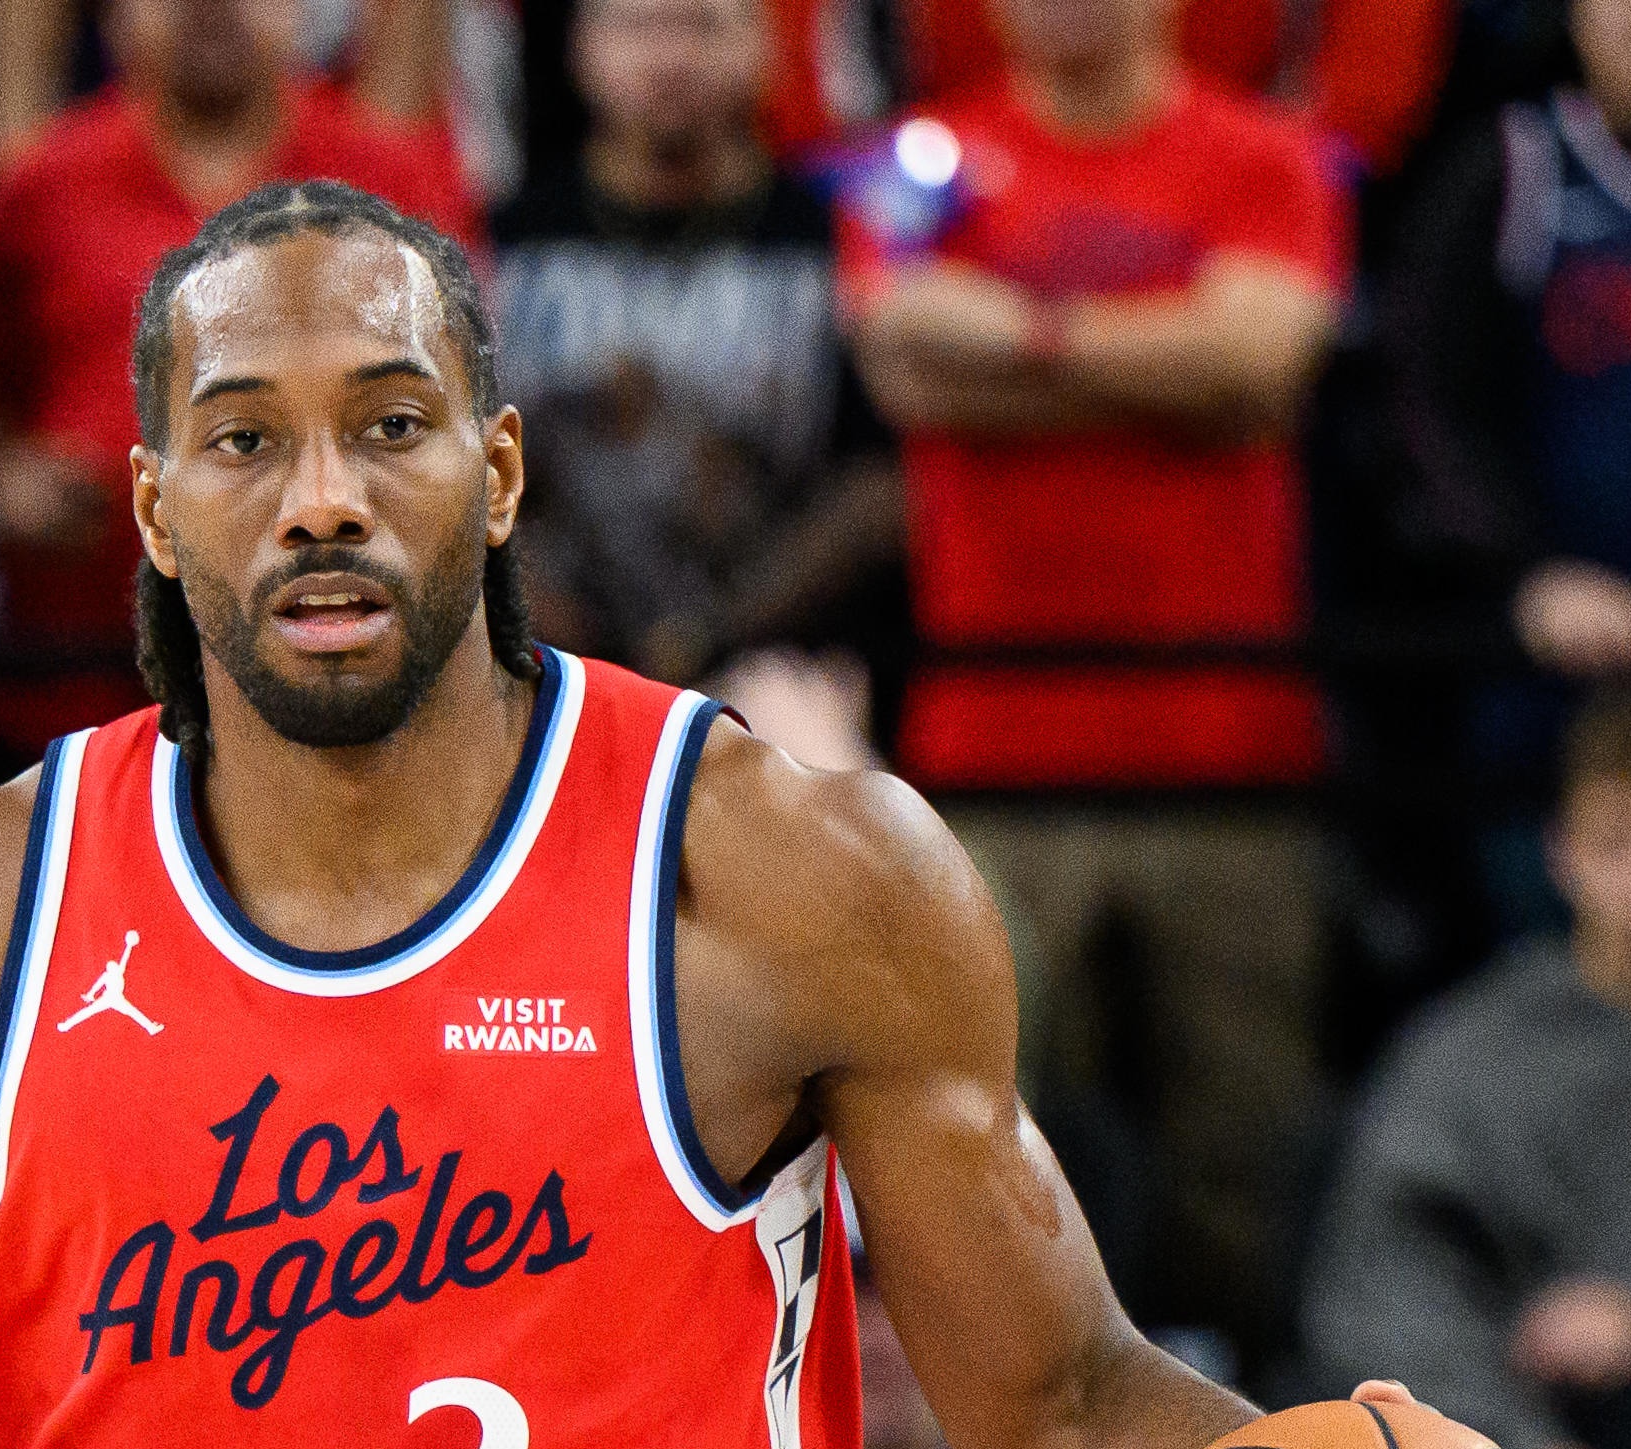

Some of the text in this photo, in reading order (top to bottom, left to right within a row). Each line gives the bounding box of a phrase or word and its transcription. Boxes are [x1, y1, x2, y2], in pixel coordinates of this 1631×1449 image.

[443, 1024, 598, 1052] RWANDA
[476, 997, 566, 1024] VISIT
[189, 1073, 424, 1243] Los
[78, 1150, 594, 1410] Angeles
